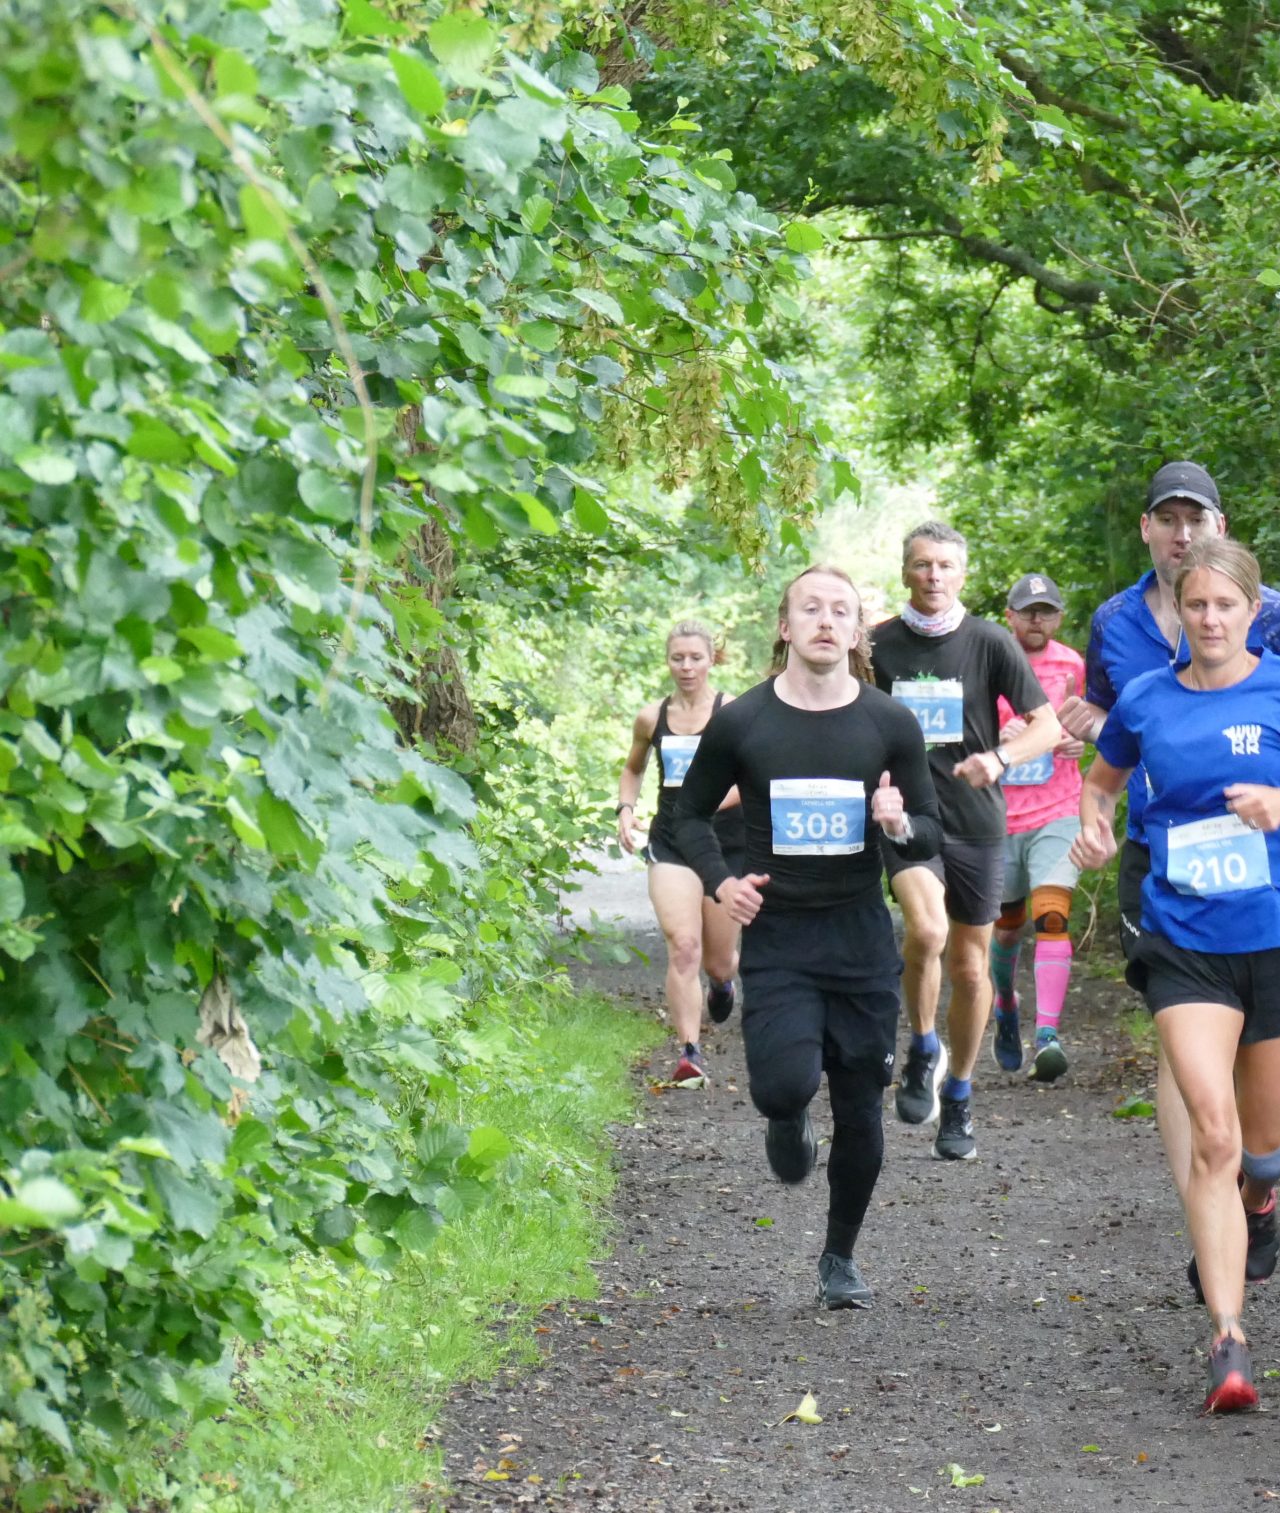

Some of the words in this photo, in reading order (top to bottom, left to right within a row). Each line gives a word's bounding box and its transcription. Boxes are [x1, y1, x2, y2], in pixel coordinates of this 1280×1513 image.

[909, 707, 947, 730] 14
[1006, 762, 1045, 782] 222
[785, 812, 848, 839] 308
[1187, 852, 1247, 889] 210
